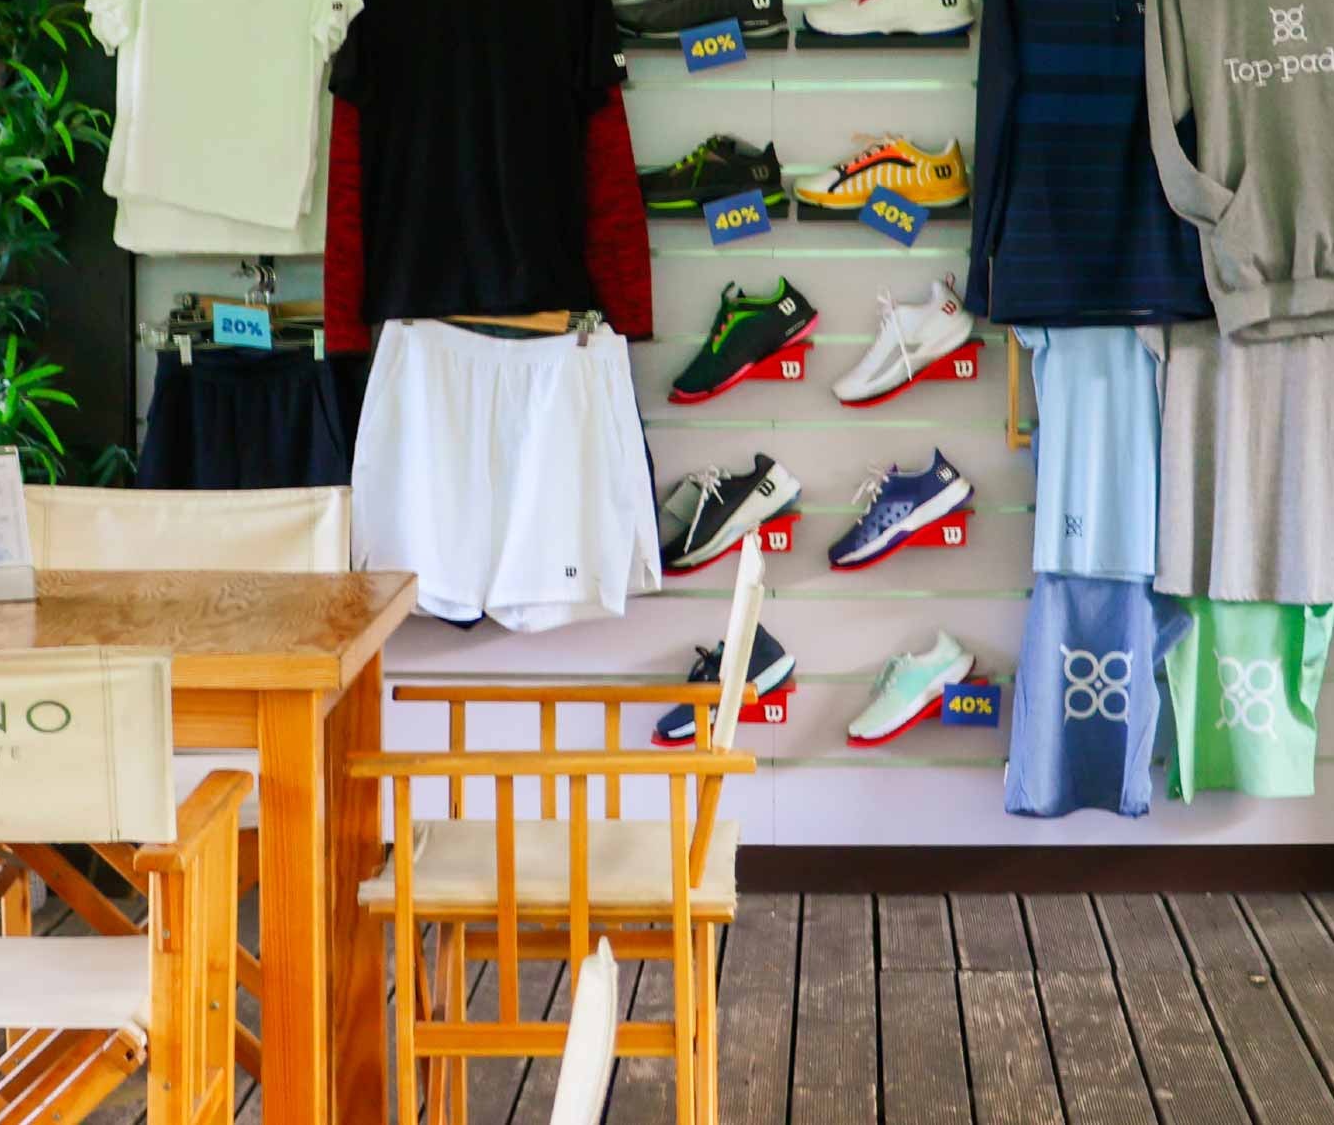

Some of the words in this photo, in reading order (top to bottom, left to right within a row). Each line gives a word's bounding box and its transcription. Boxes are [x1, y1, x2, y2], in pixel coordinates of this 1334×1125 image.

[690, 32, 736, 58] 40%
[715, 204, 760, 231] 40%
[871, 200, 916, 234] 40%
[221, 317, 264, 338] 20%
[948, 695, 993, 715] 40%
